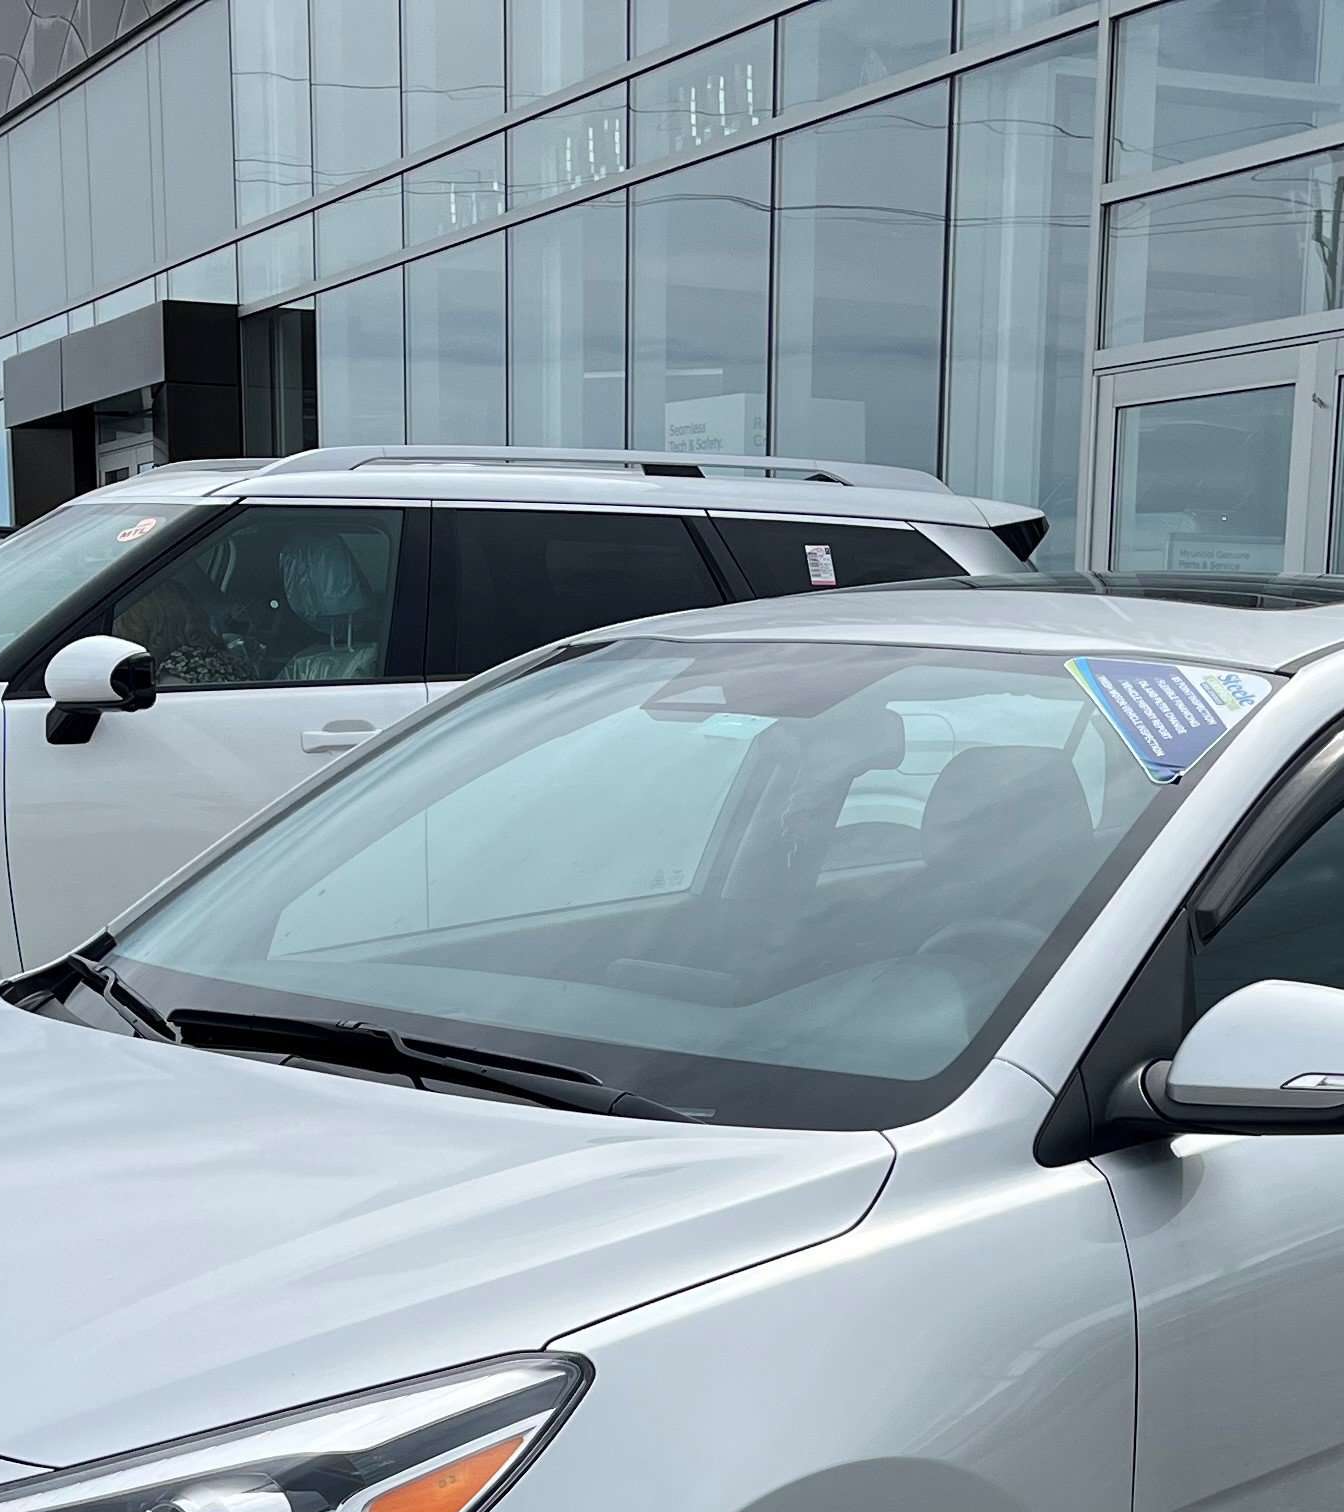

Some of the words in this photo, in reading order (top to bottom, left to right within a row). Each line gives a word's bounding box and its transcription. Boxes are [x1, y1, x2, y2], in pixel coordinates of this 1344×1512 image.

[670, 423, 705, 437] Seamless
[669, 440, 687, 452] Tech
[1179, 549, 1214, 561] Hyundai
[1179, 560, 1201, 569] Parts
[1210, 560, 1240, 570] Service
[1217, 673, 1256, 708] Steele
